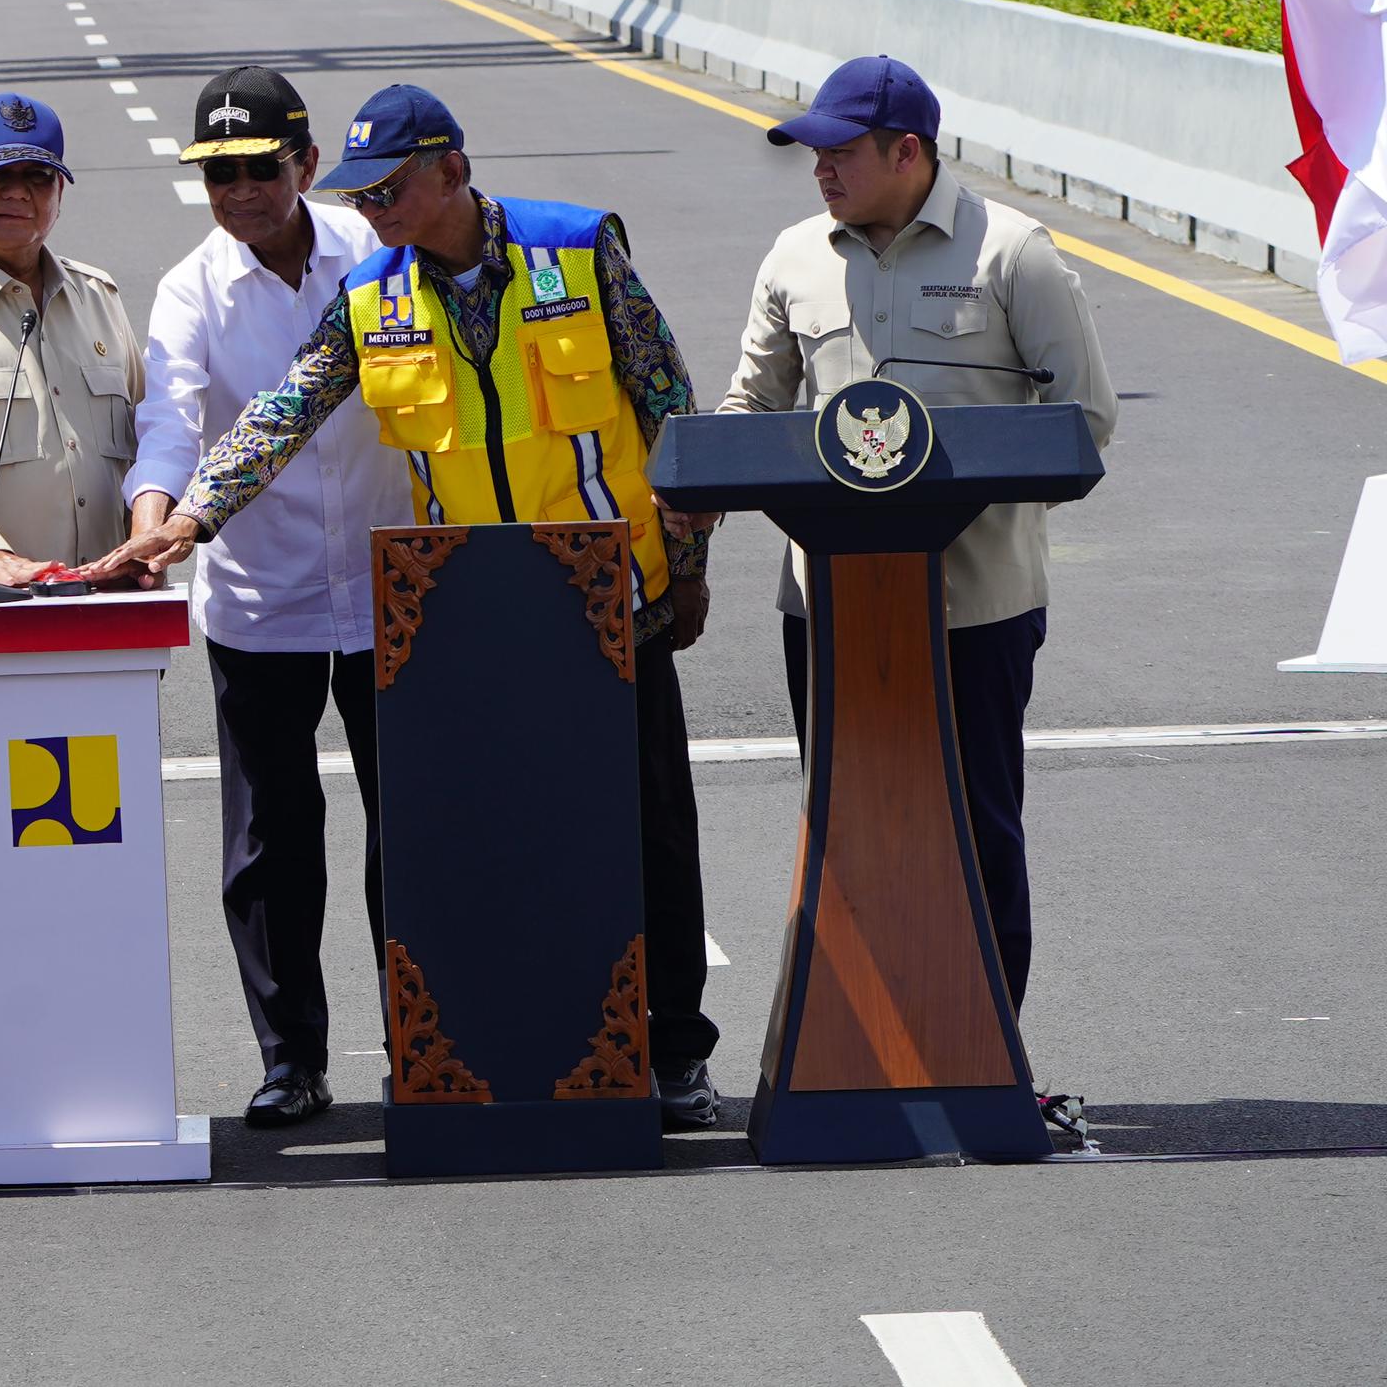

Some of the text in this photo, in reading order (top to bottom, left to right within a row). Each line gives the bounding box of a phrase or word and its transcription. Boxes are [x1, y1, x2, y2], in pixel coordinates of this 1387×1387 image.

[418, 135, 450, 146] KEMENPU
[524, 299, 587, 319] DODY HANGGODO
[368, 332, 427, 344] MENTERI PU
